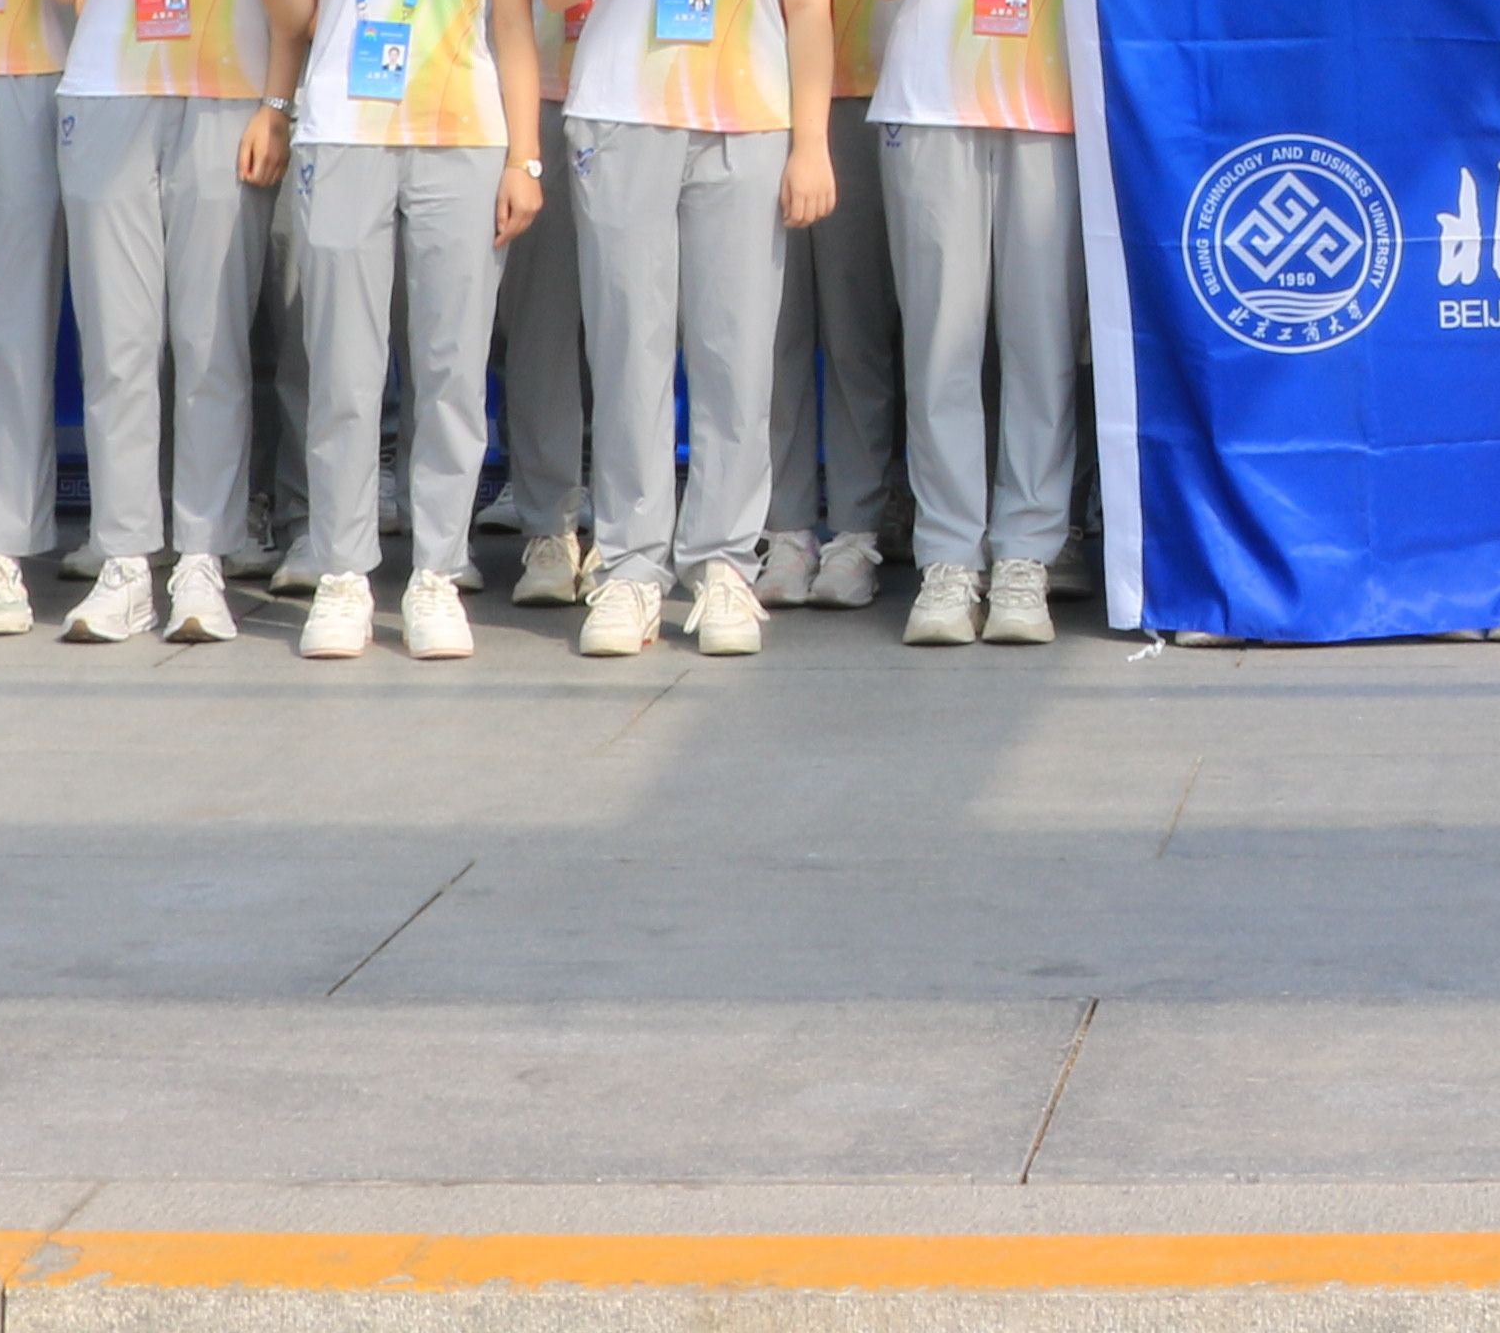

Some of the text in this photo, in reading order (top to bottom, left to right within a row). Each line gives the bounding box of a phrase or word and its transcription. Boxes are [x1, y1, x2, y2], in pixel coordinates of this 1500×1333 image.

[1196, 146, 1391, 296] BEIJING TECHNOLOGY AND BUSINESS UNIVERSITY
[1277, 272, 1316, 287] 1950
